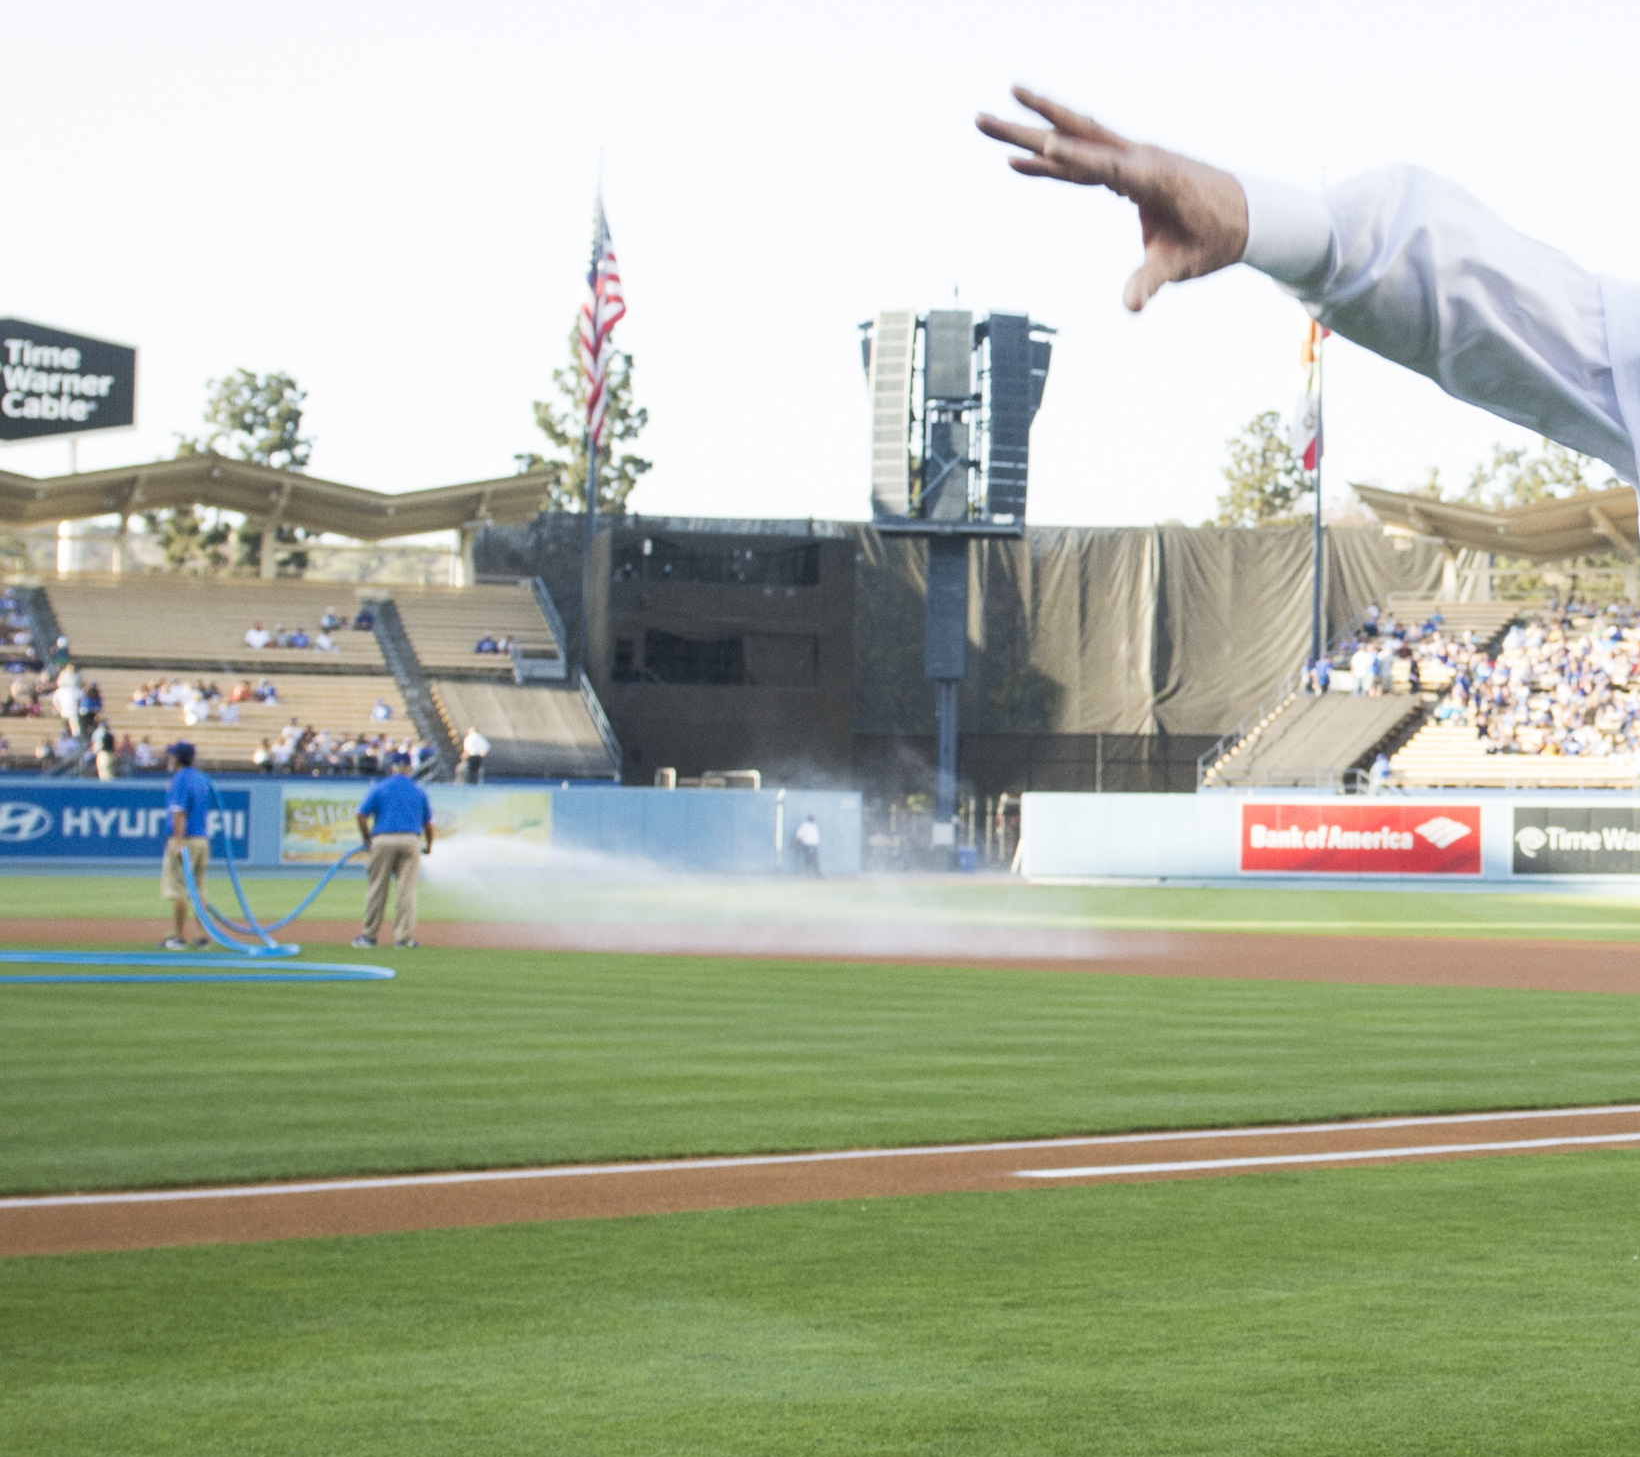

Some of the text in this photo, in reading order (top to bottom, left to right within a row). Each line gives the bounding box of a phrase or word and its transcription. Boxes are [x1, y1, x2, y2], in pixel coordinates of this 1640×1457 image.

[3, 339, 82, 370] Time
[3, 364, 115, 397] Warner
[1, 391, 89, 422] Cable
[62, 806, 245, 840] HYUNAI
[1250, 824, 1414, 850] Bank of America
[1545, 826, 1602, 851] Time
